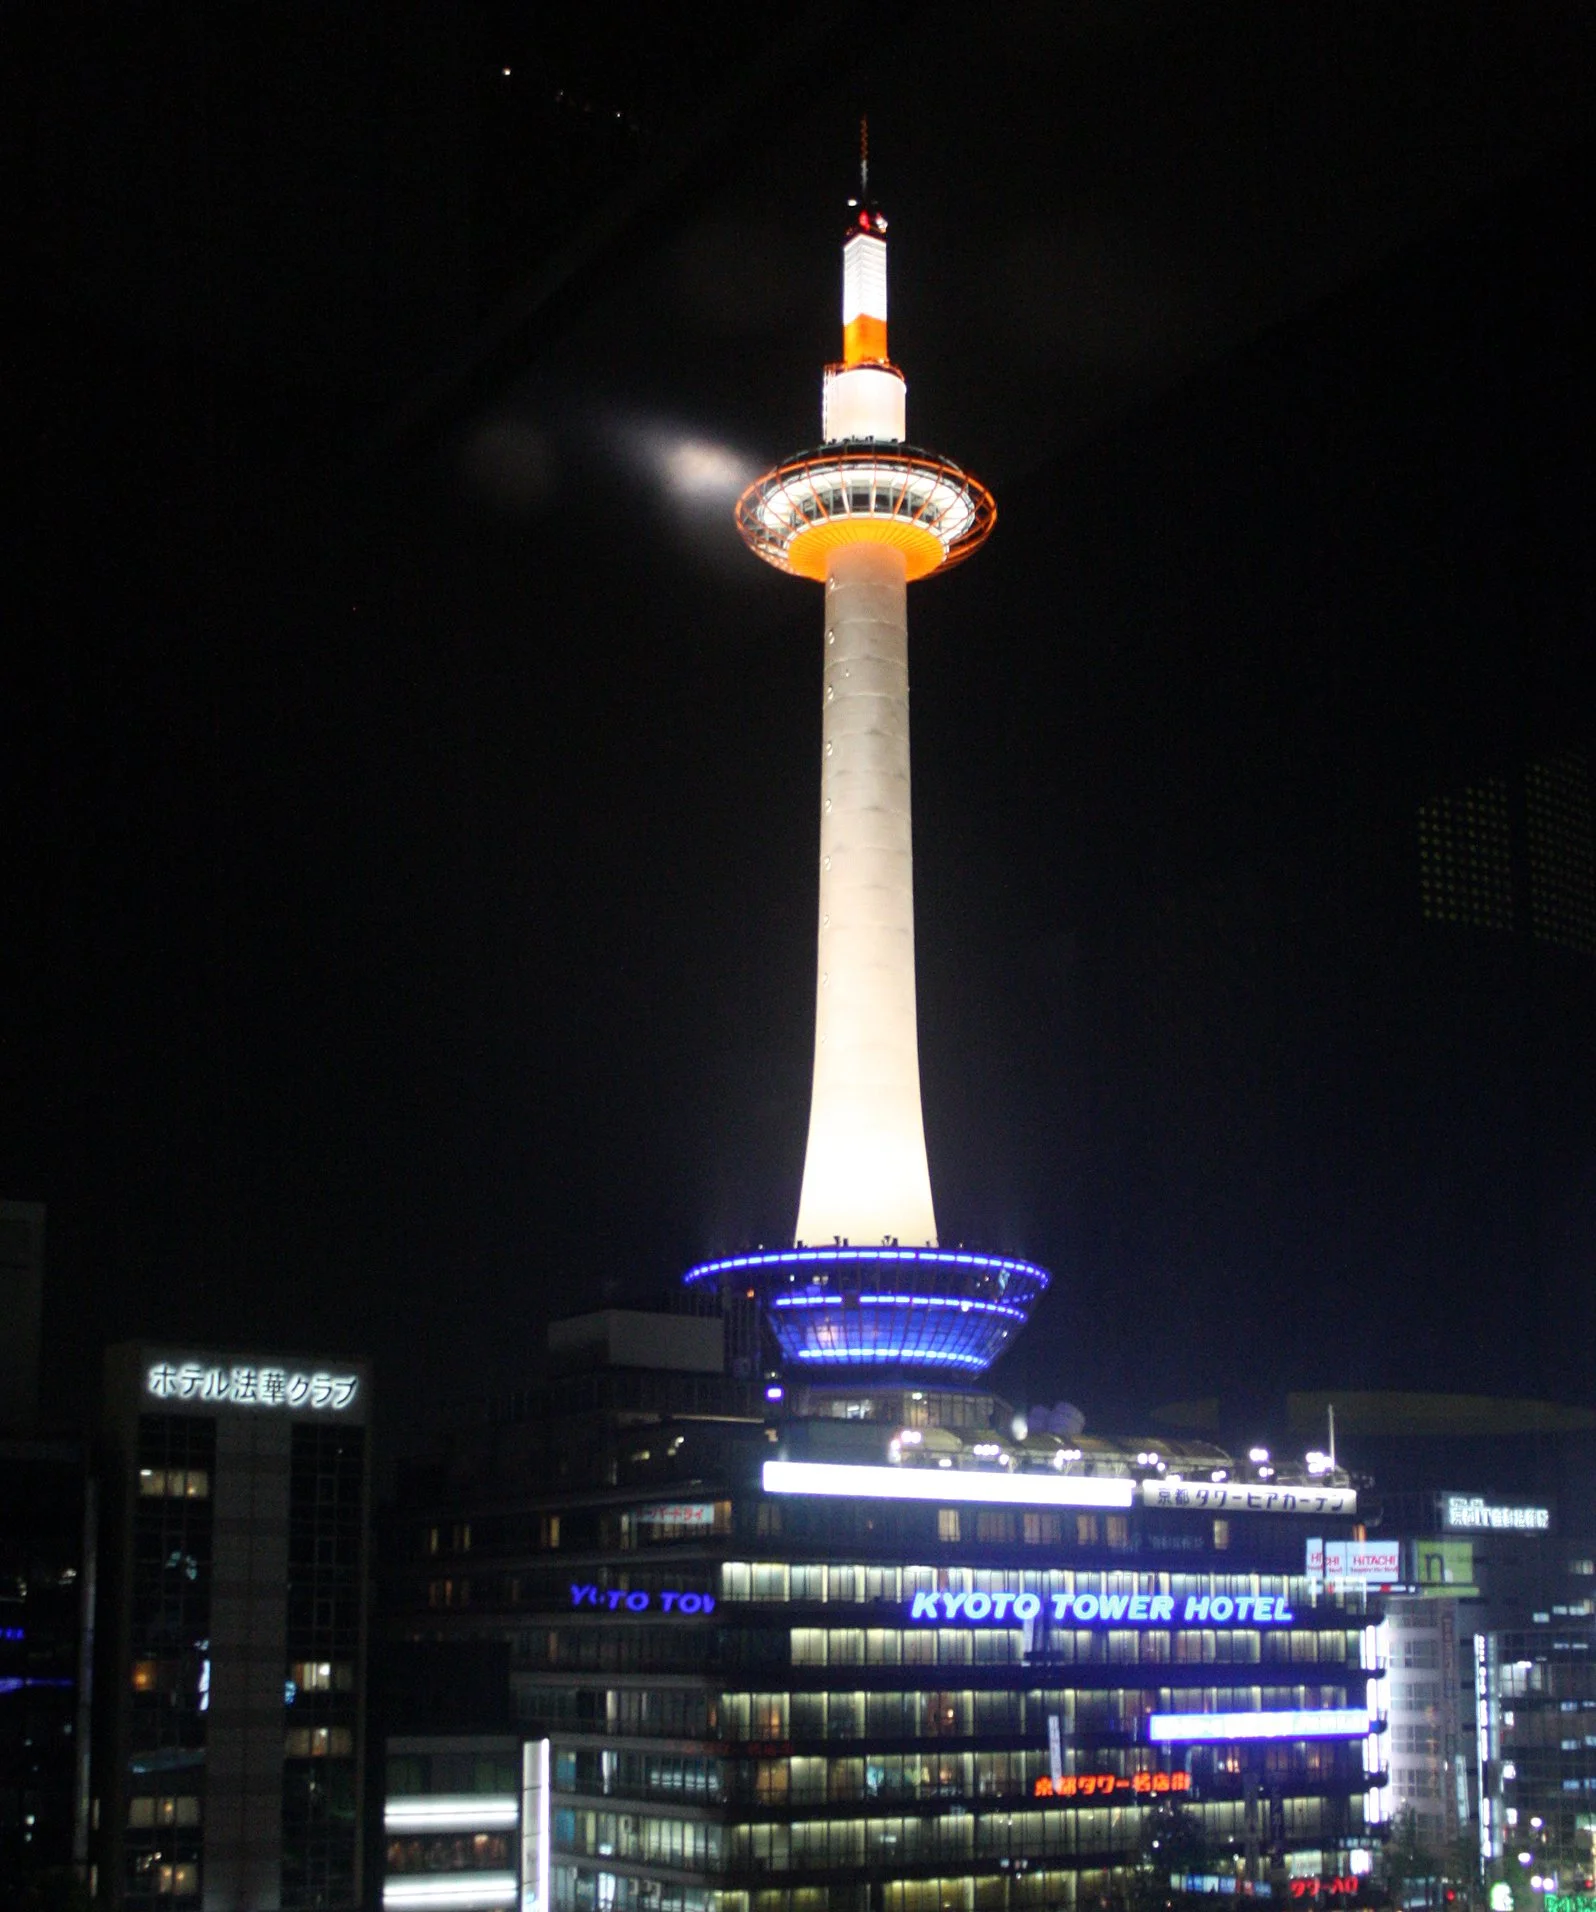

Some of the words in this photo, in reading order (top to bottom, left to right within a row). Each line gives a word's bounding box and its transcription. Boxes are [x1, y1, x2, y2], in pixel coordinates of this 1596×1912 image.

[150, 1361, 359, 1408] ホテル法華クラブ
[1353, 1555, 1396, 1566] HITACHI
[910, 1592, 1041, 1621] KYOTO
[1050, 1594, 1175, 1621] TOWER
[1184, 1596, 1293, 1622] HOTEL
